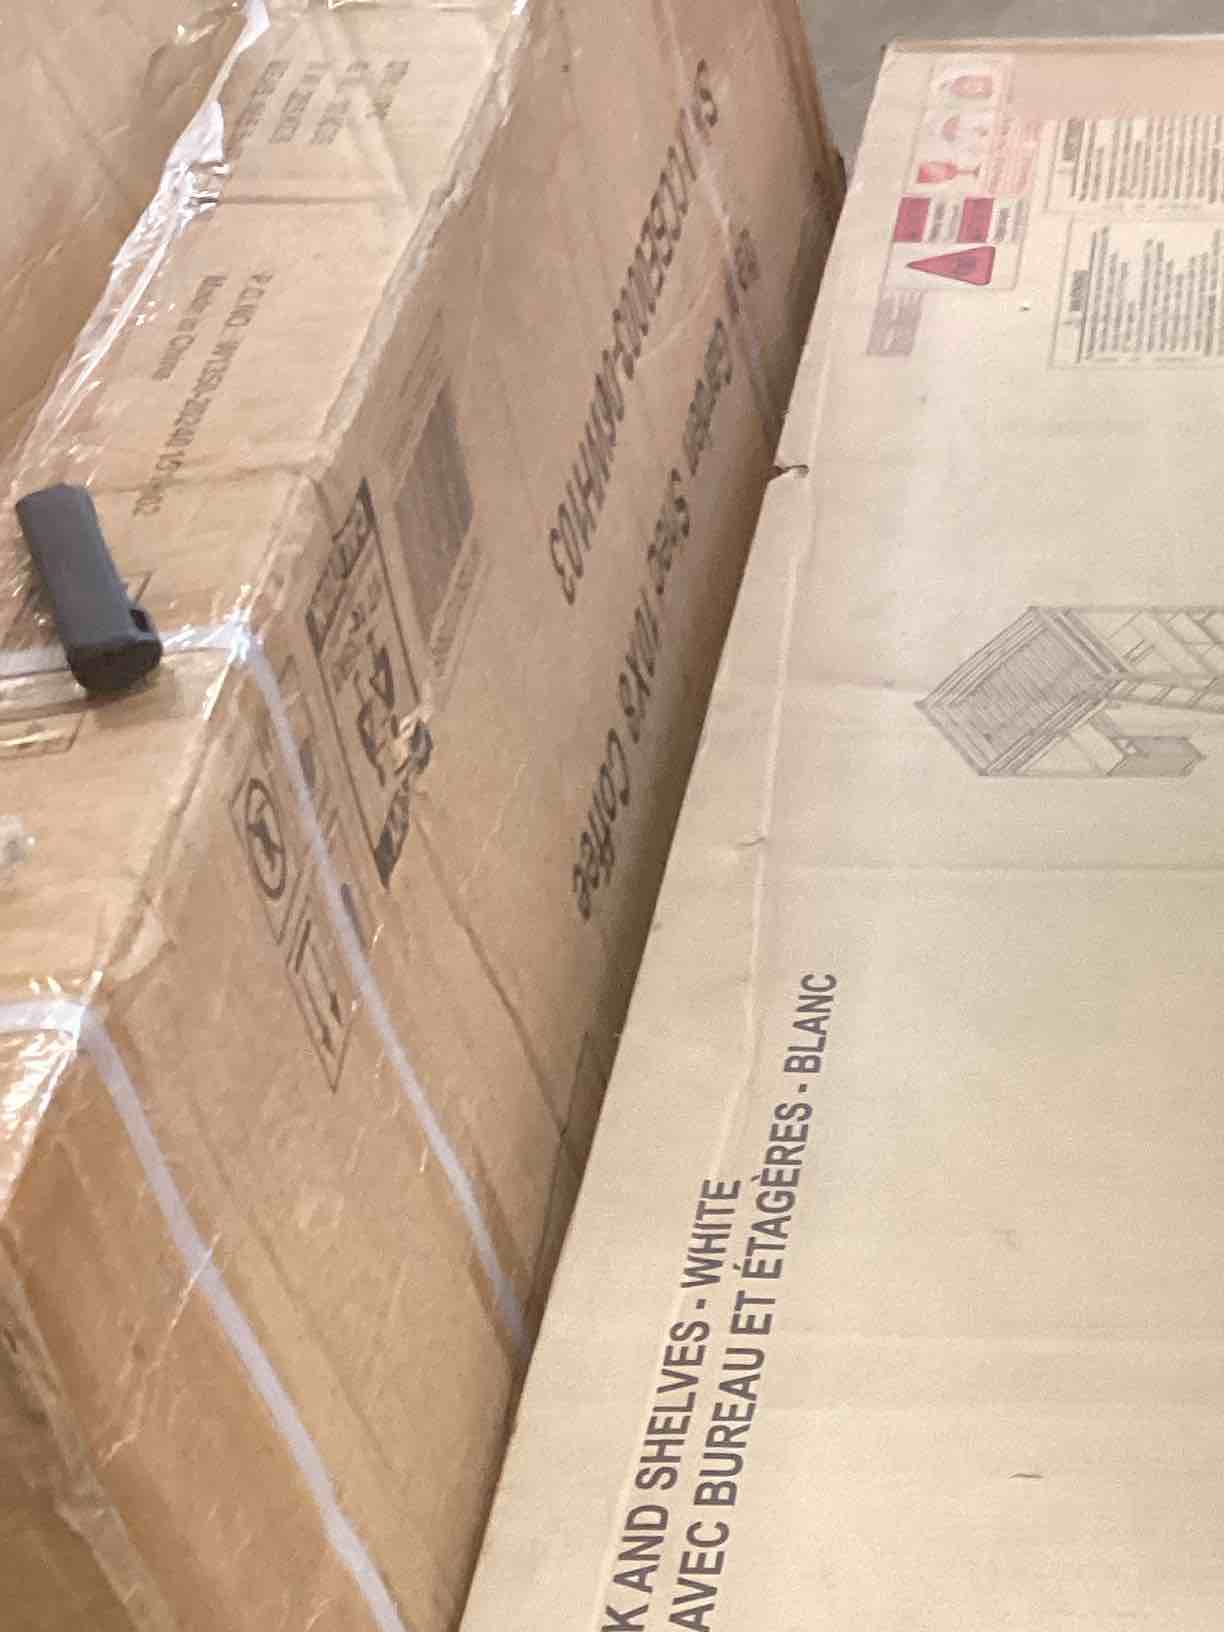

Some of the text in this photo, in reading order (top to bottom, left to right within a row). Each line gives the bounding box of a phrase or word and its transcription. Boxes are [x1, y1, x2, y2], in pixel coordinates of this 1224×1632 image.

[573, 728, 630, 920] Coffee
[783, 974, 837, 1073] BLANC
[681, 1180, 741, 1288] WHITE
[735, 1103, 813, 1279] ÉTAGÈRES
[736, 1290, 775, 1335] ET
[635, 1321, 710, 1490] SHELVES
[696, 1348, 765, 1506] BUREAU
[613, 1505, 668, 1594] AND
